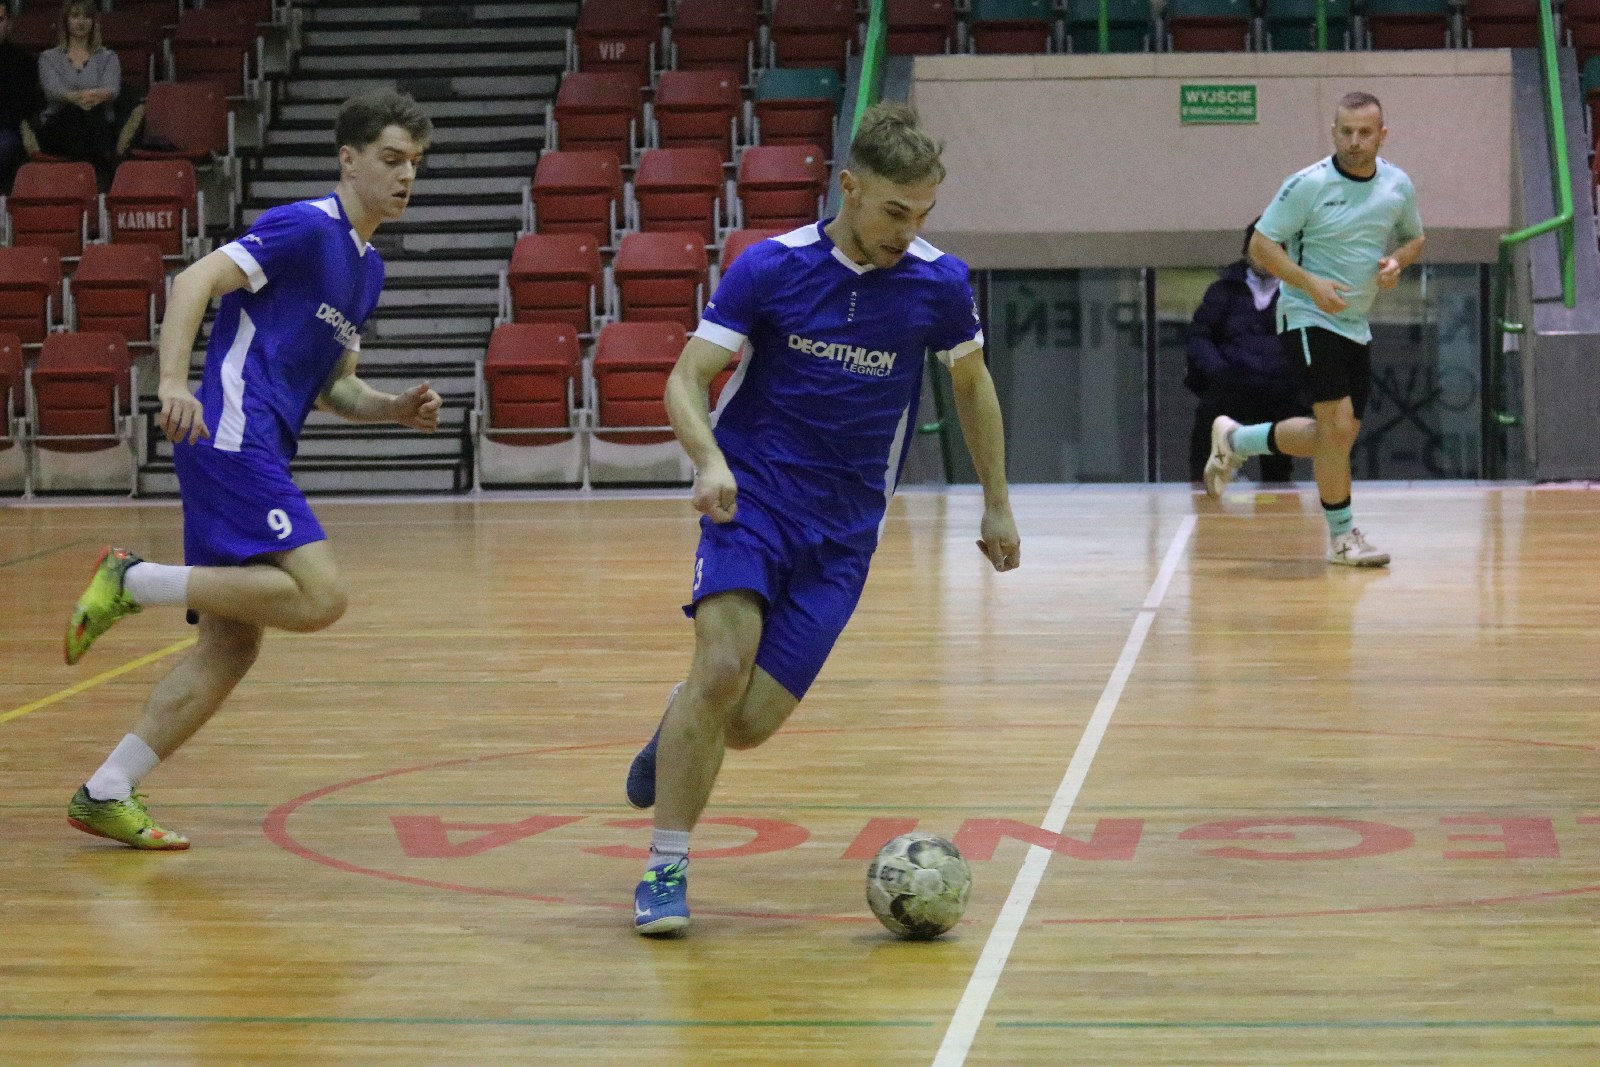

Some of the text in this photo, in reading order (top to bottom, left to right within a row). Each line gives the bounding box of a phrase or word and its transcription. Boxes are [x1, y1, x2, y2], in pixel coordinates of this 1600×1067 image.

[599, 42, 625, 60] VIP
[1185, 88, 1252, 104] WYJŚCIE
[118, 211, 173, 230] KARNET
[788, 334, 897, 370] DECATHLON
[842, 362, 891, 377] LEGNICA
[267, 508, 293, 540] 9
[389, 815, 1600, 860] EGNICA
